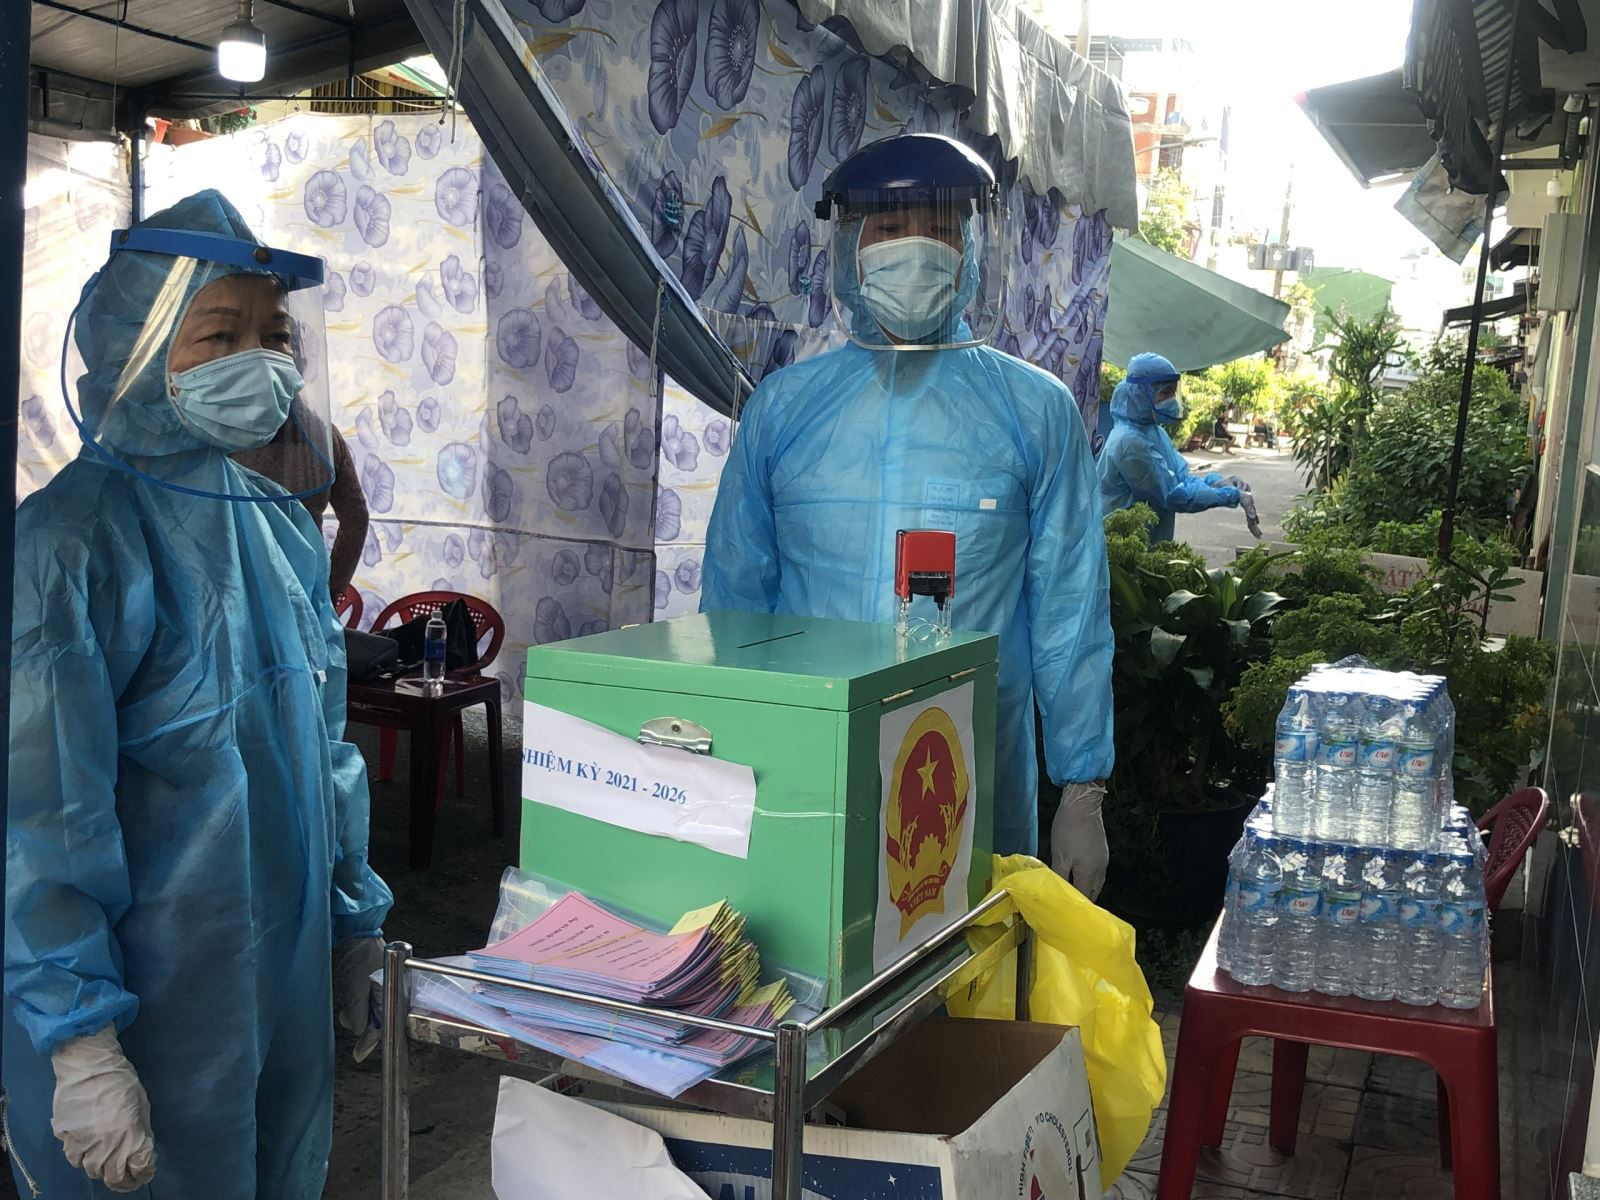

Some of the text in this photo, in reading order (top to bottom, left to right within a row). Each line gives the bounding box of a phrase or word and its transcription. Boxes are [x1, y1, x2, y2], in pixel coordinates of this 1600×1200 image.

[576, 761, 601, 782] KỲ
[605, 770, 638, 793] 2021
[652, 782, 688, 805] 2026
[1045, 1112, 1073, 1175] CHOLESTEROL
[1018, 1162, 1026, 1196] HIGH
